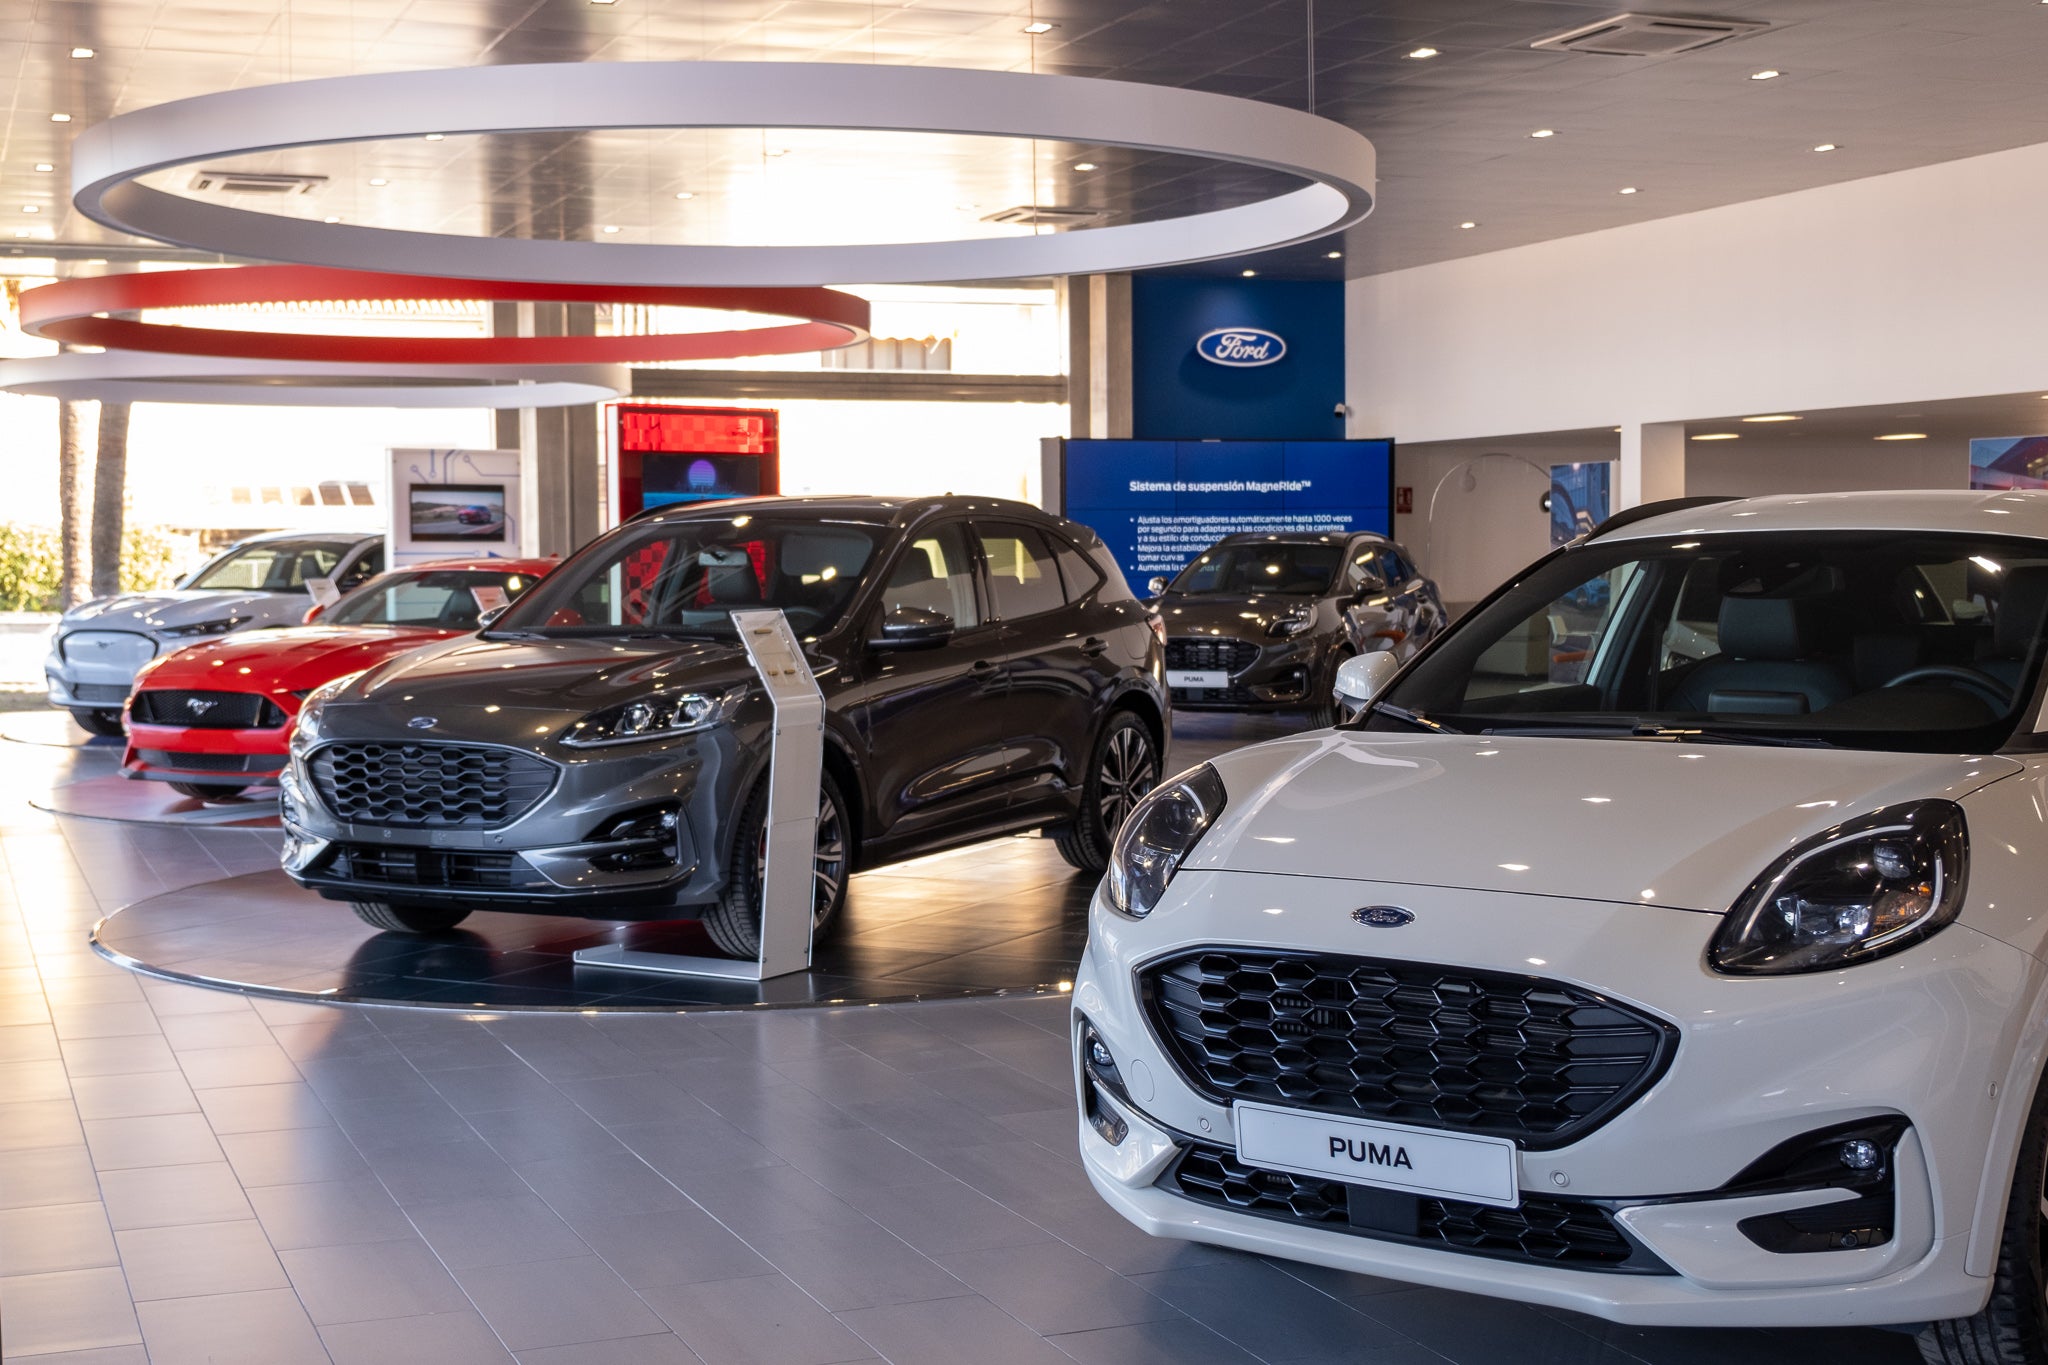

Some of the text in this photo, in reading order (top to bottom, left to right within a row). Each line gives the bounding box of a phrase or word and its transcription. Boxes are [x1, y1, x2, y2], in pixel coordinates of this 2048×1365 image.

[1215, 333, 1270, 360] Ford
[1129, 480, 1172, 492] Sistema
[1173, 480, 1187, 492] de
[1188, 480, 1245, 493] suspensión
[1137, 514, 1353, 525] Ajusta los amortiguadores automáticamente hasta 1000 veces
[1137, 525, 1150, 534] por
[1151, 525, 1182, 534] segundo
[1183, 526, 1199, 534] para
[1200, 524, 1235, 534] adaptarse
[1242, 524, 1253, 533] las
[1253, 524, 1295, 532] condiciones
[1295, 524, 1305, 532] de
[1305, 524, 1313, 532] la
[1313, 524, 1345, 532] carretera
[1158, 534, 1179, 542] estilo
[1179, 534, 1190, 542] de
[1137, 544, 1162, 553] Mejora
[1162, 544, 1170, 552] la
[1137, 554, 1160, 562] tomar
[1137, 563, 1171, 572] Aumenta
[1171, 563, 1179, 571] la
[1329, 1136, 1413, 1170] PUMA
